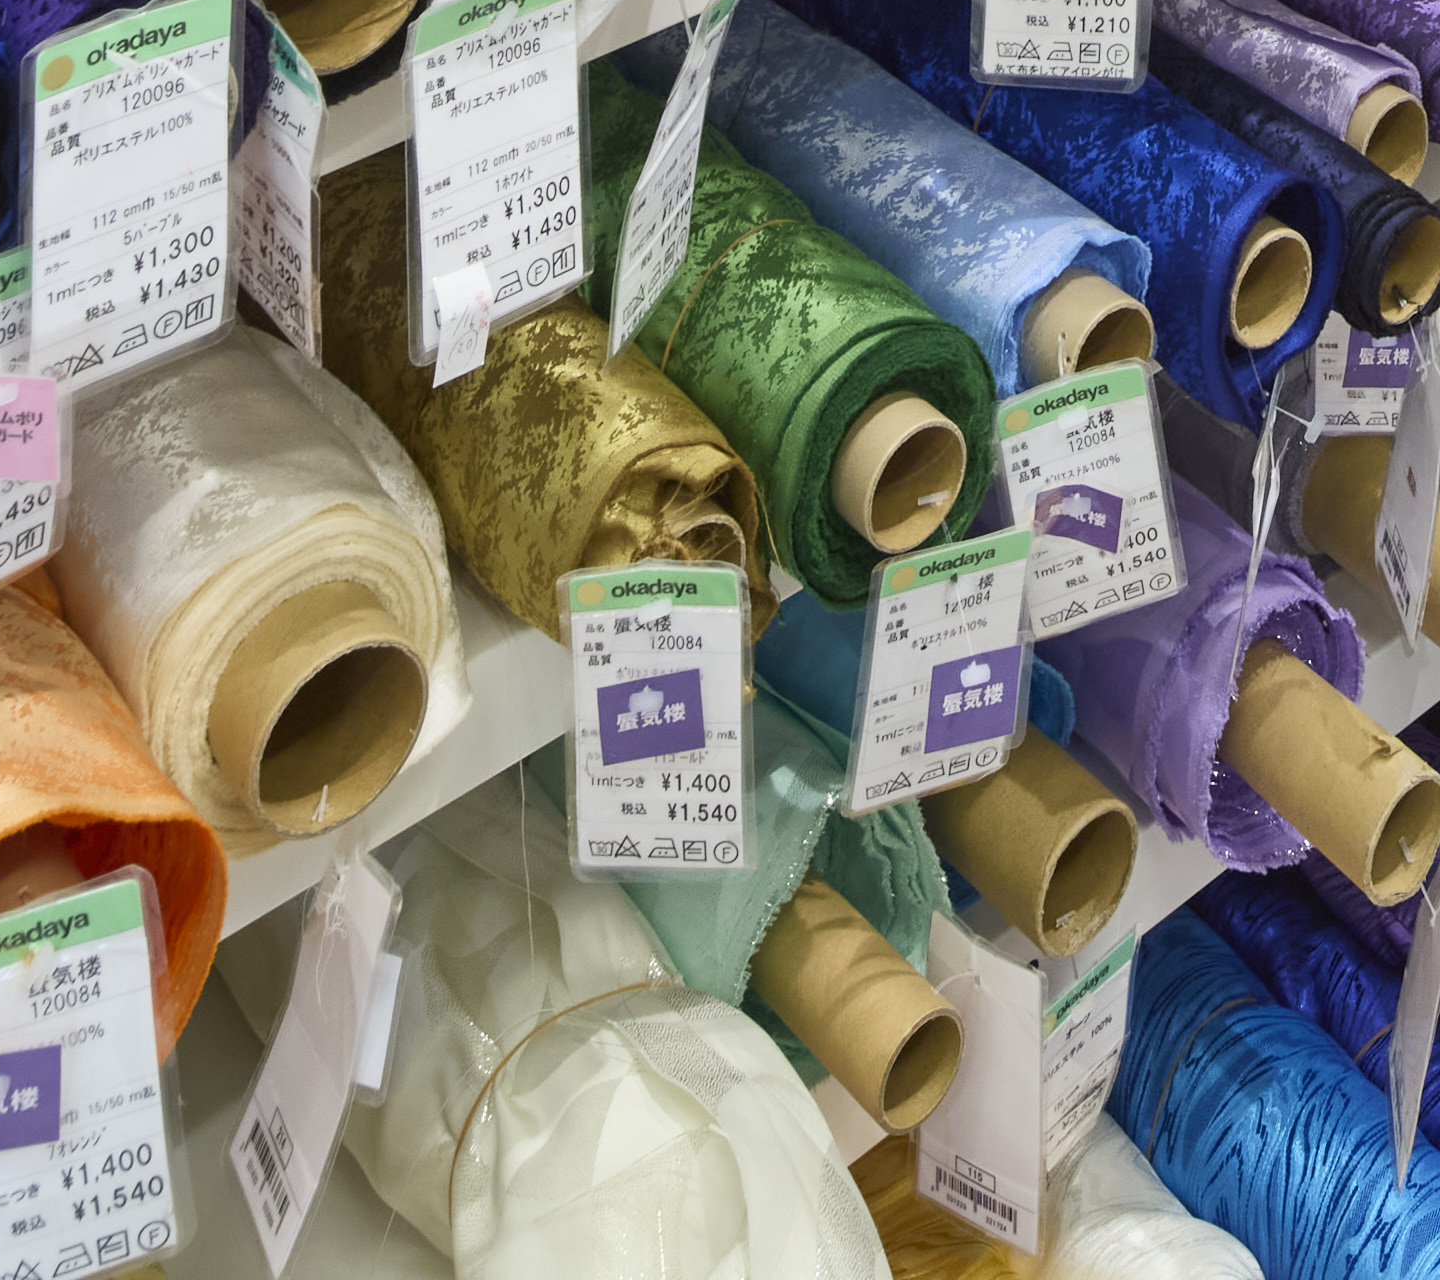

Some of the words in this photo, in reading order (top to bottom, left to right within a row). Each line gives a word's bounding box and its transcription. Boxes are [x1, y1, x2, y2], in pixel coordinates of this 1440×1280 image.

[85, 16, 188, 68] okadaya
[1067, 15, 1131, 35] ¥1,210
[487, 37, 542, 70] 120096
[120, 75, 186, 114] 120096
[448, 67, 549, 119] ポリエステル100%
[72, 111, 194, 168] ポリエステル100%
[495, 166, 535, 192] 1ホワイト
[503, 175, 572, 220] ¥1,300
[510, 205, 578, 251] ¥1,430
[132, 225, 215, 274] ¥1,300
[84, 300, 117, 322] 税込
[138, 256, 221, 307] ¥1,430
[1031, 379, 1110, 419] okadaya
[1066, 425, 1117, 453] 120084
[1104, 545, 1169, 578] ¥1,540
[610, 576, 699, 599] okadaya
[648, 634, 704, 651] 120084
[615, 701, 687, 734] 蜃気楼
[941, 681, 1006, 718] 蜃気楼
[660, 772, 732, 794] ¥1,400
[667, 802, 738, 824] ¥1,540
[30, 979, 102, 1019] 120084
[61, 1142, 154, 1191] ¥1,400
[10, 1213, 47, 1238] 税込
[71, 1173, 165, 1221] ¥1,540
